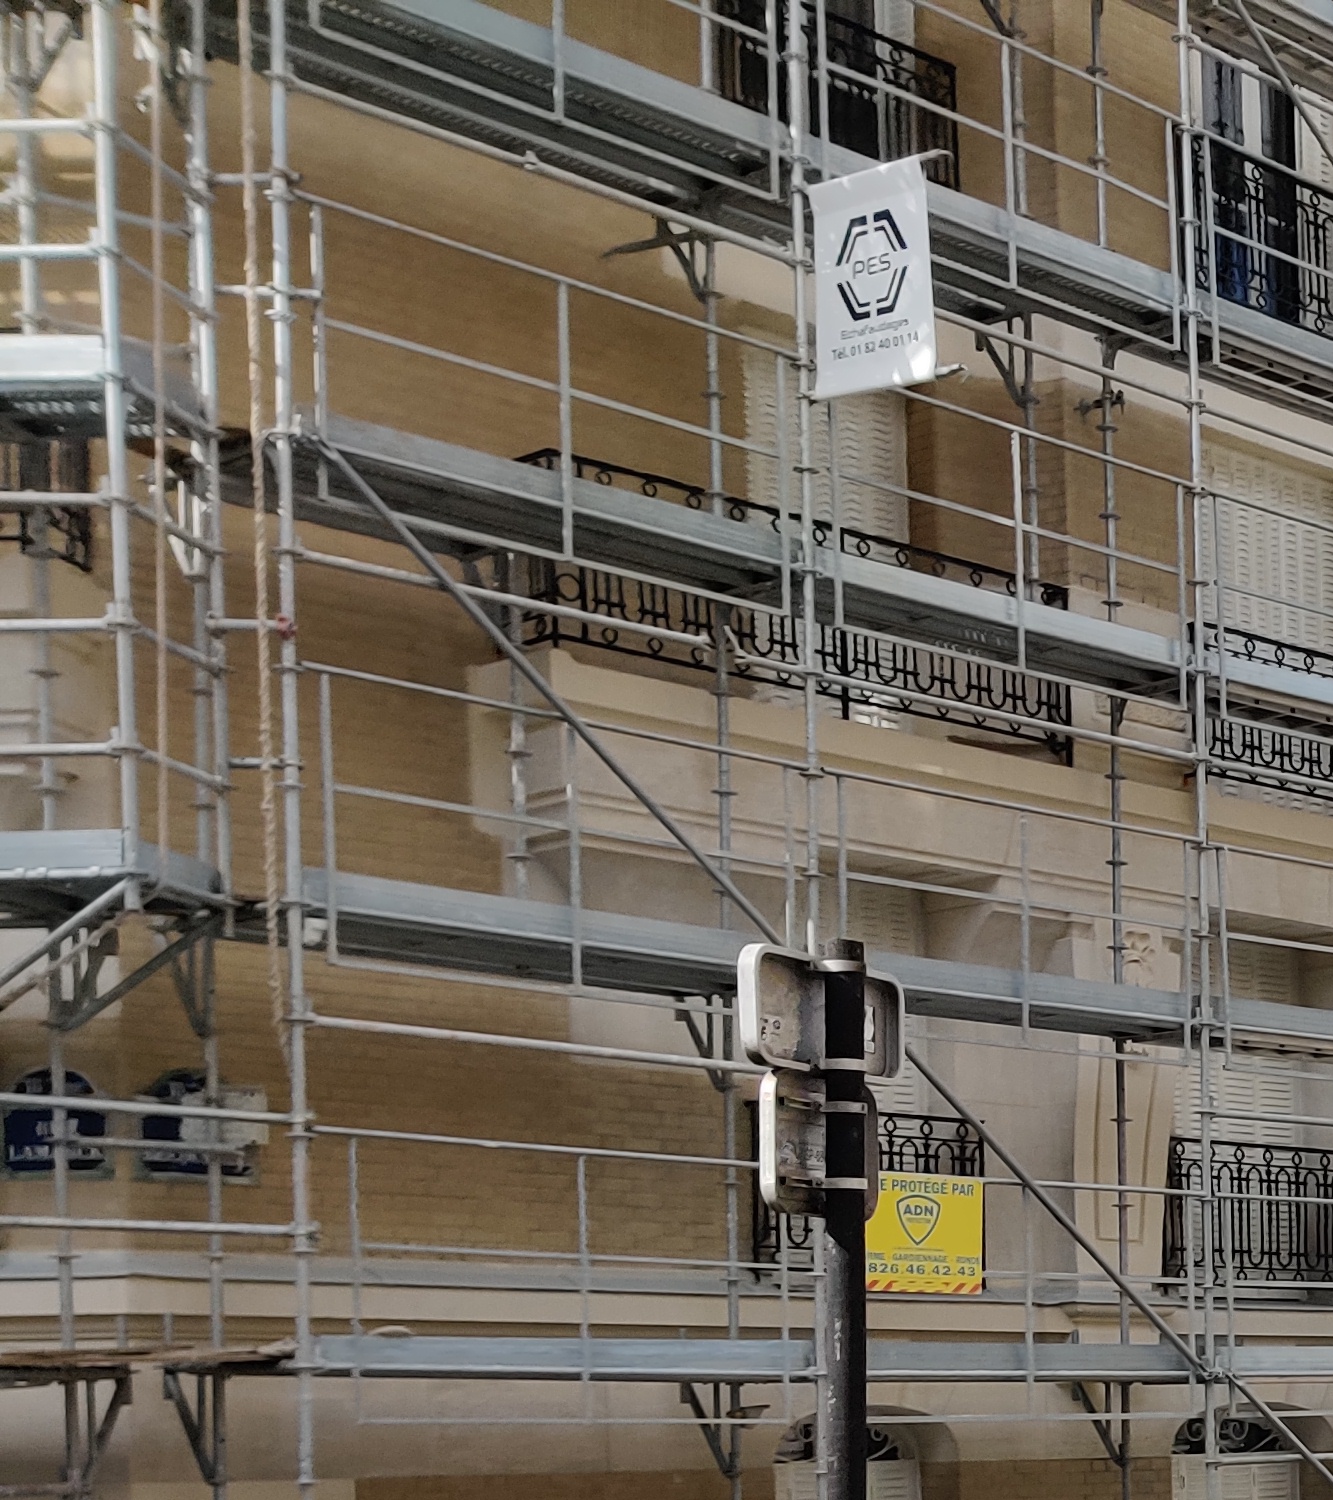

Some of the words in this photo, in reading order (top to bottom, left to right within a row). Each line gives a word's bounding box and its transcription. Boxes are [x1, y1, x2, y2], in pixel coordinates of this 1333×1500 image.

[852, 252, 891, 280] PES
[891, 1177, 949, 1195] PROTÉGÉ
[951, 1182, 975, 1196] PAR
[903, 1203, 934, 1217] ADN
